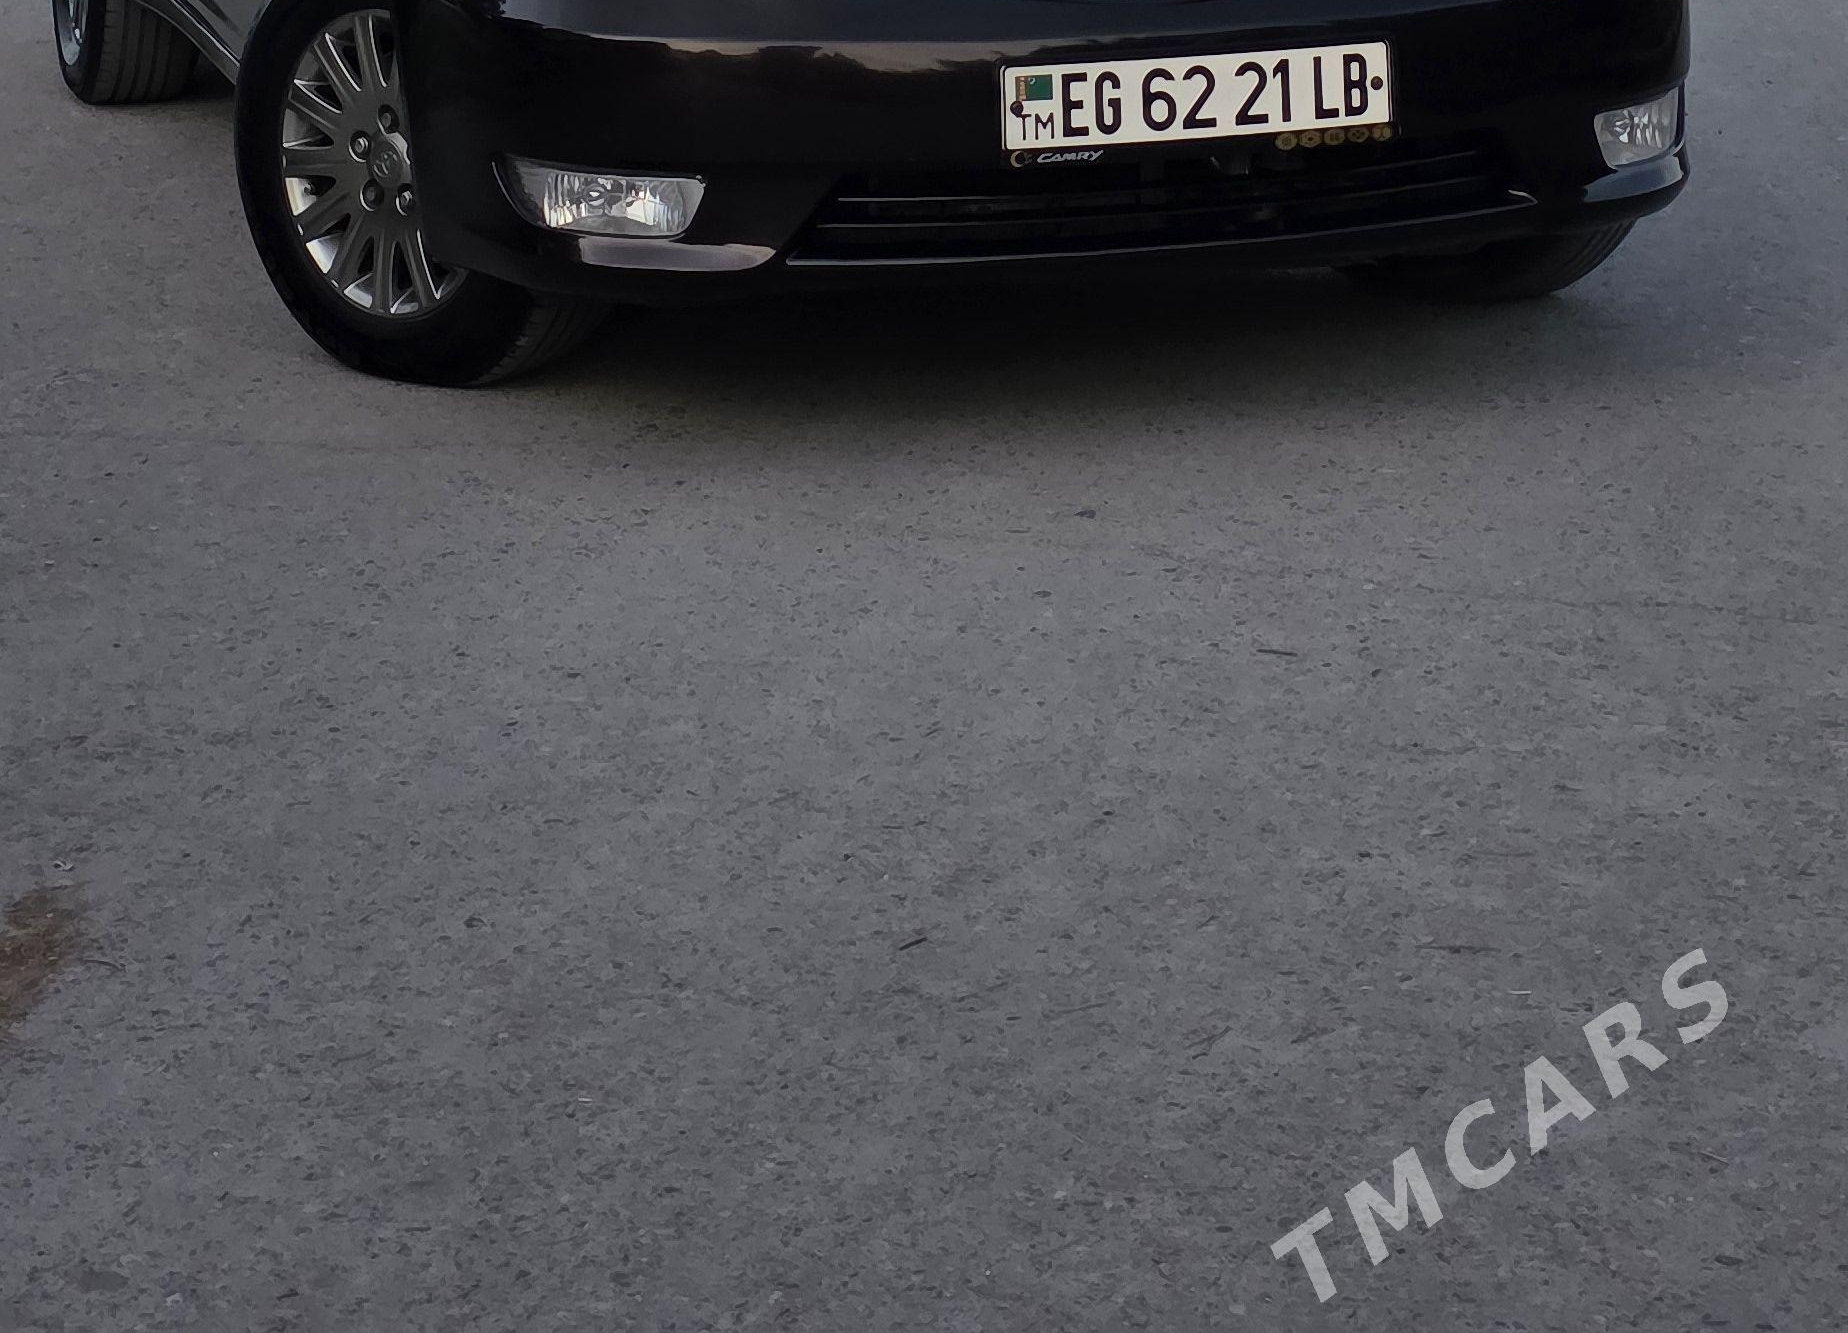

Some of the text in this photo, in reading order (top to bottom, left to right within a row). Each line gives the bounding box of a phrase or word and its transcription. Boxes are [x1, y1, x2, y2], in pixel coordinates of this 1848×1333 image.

[1061, 53, 1368, 137] EG 62 21 LB
[1019, 112, 1055, 140] TM
